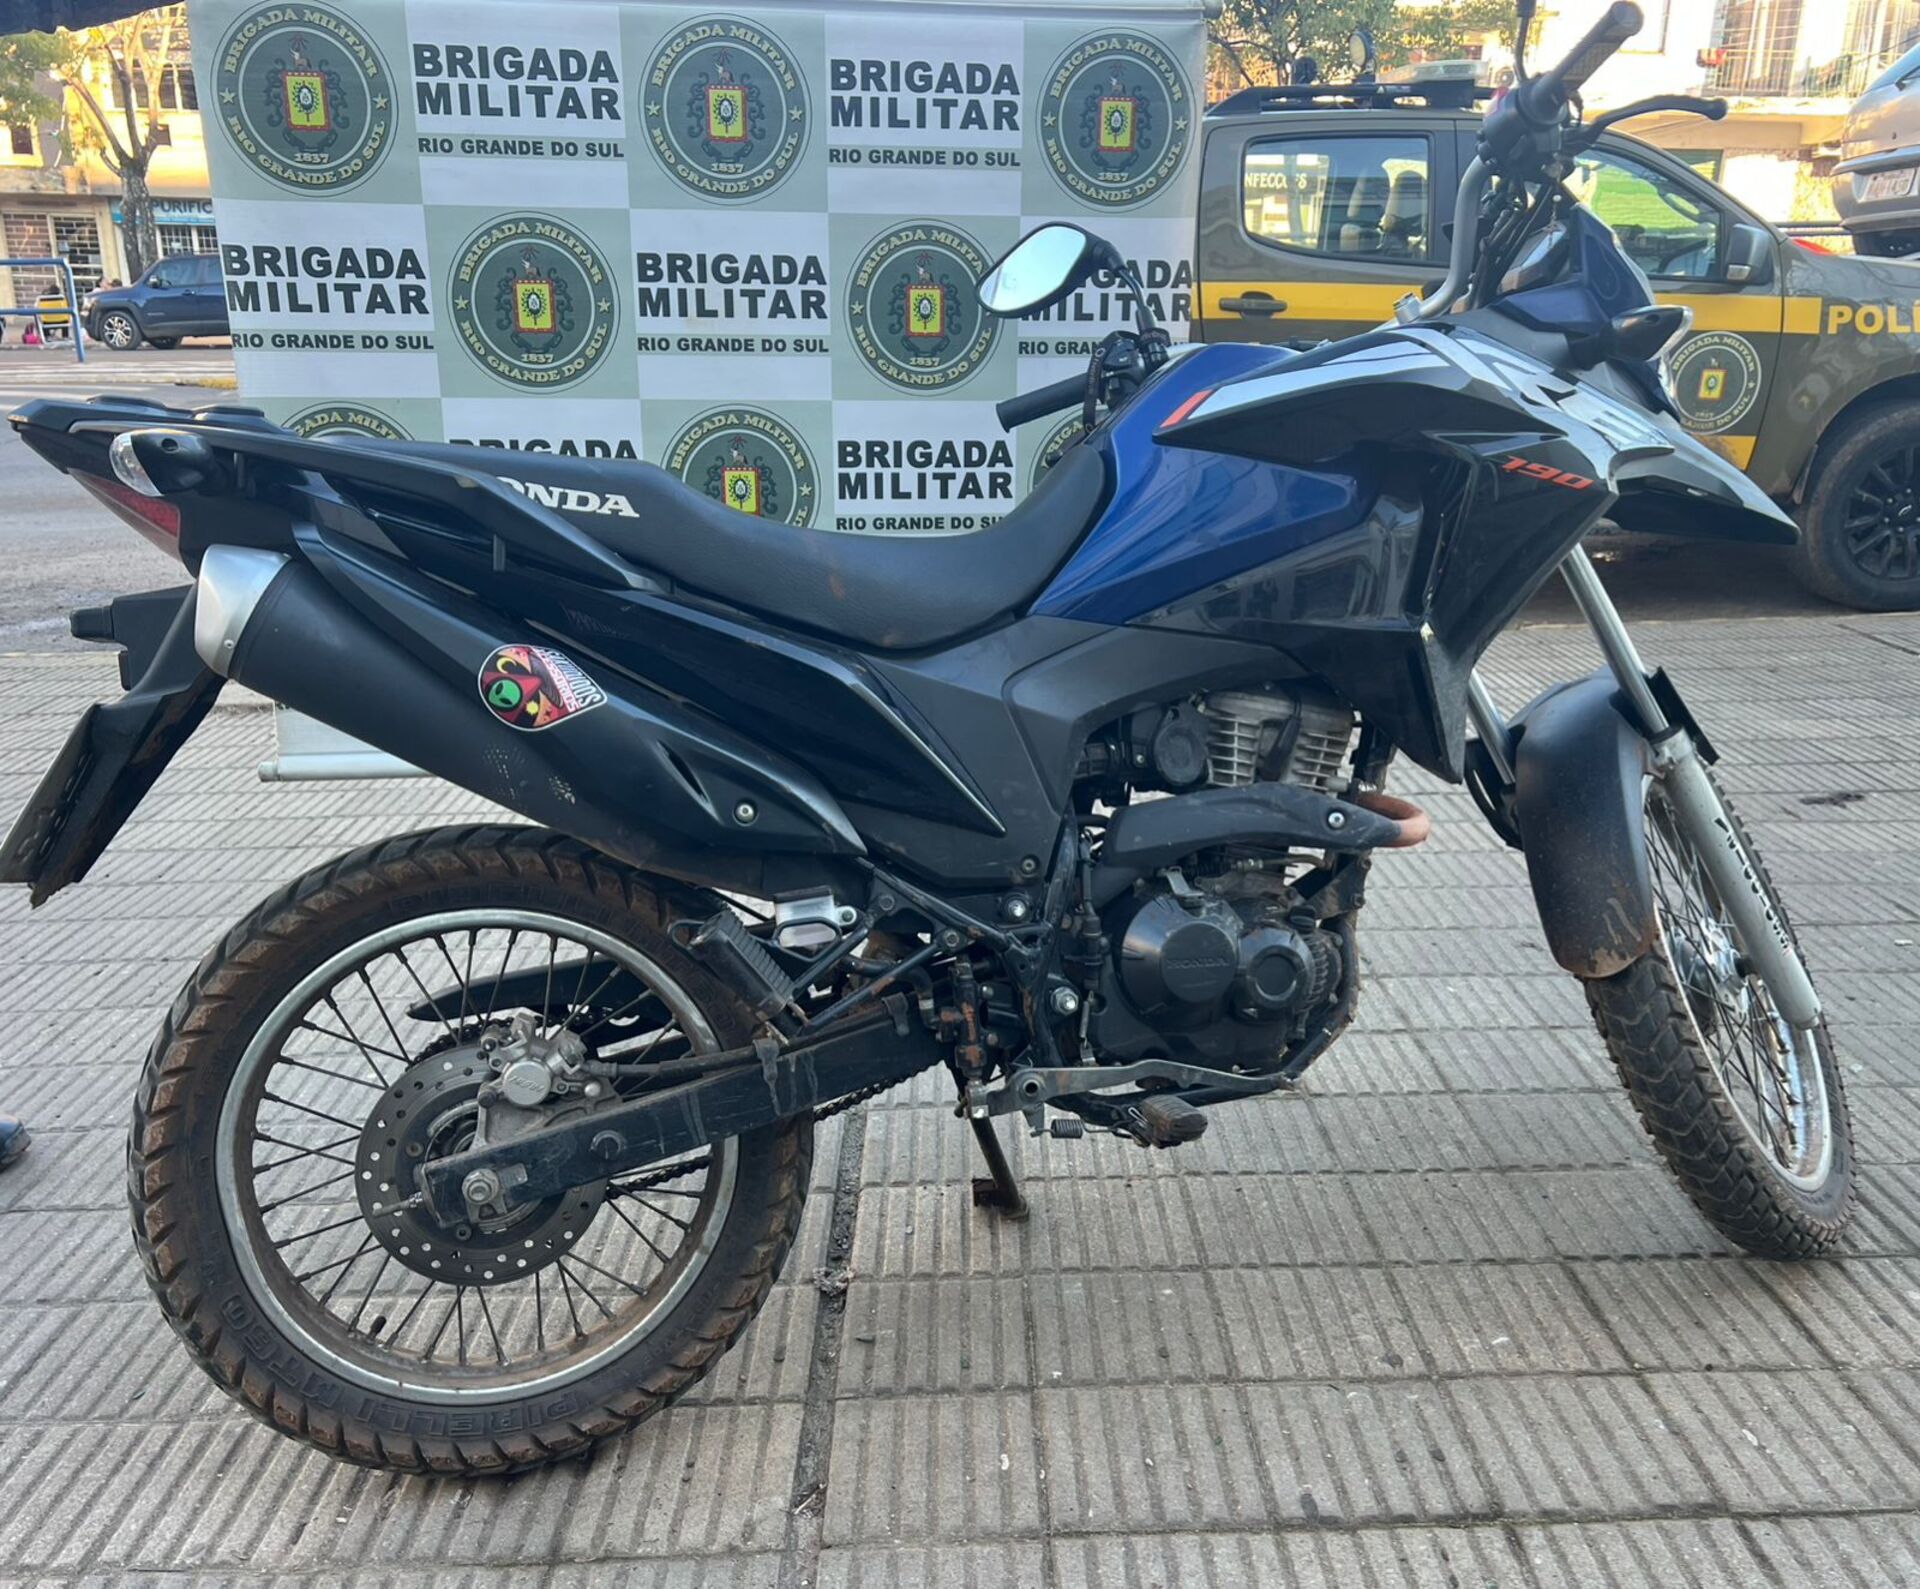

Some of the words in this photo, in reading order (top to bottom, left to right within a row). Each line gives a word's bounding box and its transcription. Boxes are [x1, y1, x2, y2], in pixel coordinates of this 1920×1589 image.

[224, 8, 299, 73] BRIGADA
[304, 9, 378, 77] MILITAR
[652, 24, 725, 88] BRIGADA
[729, 25, 797, 91] MILITAR
[412, 43, 619, 83] BRIGADA
[830, 59, 1020, 95] BRIGADA
[1050, 38, 1121, 98] BRIGADA
[1125, 39, 1183, 101] MILITAR
[416, 82, 621, 120] MILITAR
[831, 96, 1020, 131] MILITAR
[227, 116, 257, 154] RIO
[259, 154, 337, 185] GRANDE
[339, 158, 363, 179] DO
[363, 120, 385, 159] SUL
[294, 153, 329, 164] 1837
[418, 138, 454, 154] RIO
[461, 139, 545, 156] GRANDE
[551, 141, 578, 157] DO
[585, 143, 624, 158] SUL
[651, 127, 676, 165] RIO
[677, 164, 750, 193] GRANDE
[752, 169, 776, 188] DO
[775, 132, 800, 170] SUL
[829, 149, 862, 164] RIO
[868, 150, 946, 165] GRANDE
[953, 151, 979, 166] DO
[985, 152, 1020, 167] SUL
[1046, 138, 1067, 174] RIO
[1067, 173, 1133, 201] GRANDE
[1136, 176, 1157, 195] DO
[1157, 141, 1182, 178] SUL
[221, 244, 426, 280] BRIGADA
[459, 221, 530, 282] BRIGADA
[535, 222, 603, 284] MILITAR
[636, 252, 827, 285] BRIGADA
[856, 228, 927, 288] BRIGADA
[931, 229, 985, 275] MILITA
[1078, 260, 1192, 289] GADA
[226, 280, 430, 314] MILITAR
[638, 287, 828, 319] MILITAR
[232, 333, 264, 349] RIO
[271, 334, 355, 350] GRANDE
[361, 335, 389, 350] DO
[395, 335, 434, 350] SUL
[460, 320, 486, 356] RIO
[487, 354, 561, 382] GRANDE
[562, 358, 586, 377] DO
[585, 322, 609, 359] SUL
[520, 353, 554, 363] 1837
[637, 337, 670, 351] RIO
[677, 337, 755, 352] GRANDE
[761, 338, 787, 353] DO
[793, 339, 829, 353] SUL
[854, 325, 877, 359] RIO
[877, 357, 945, 385] GRANDE
[947, 361, 970, 379] DO
[969, 327, 992, 362] SUL
[1018, 341, 1049, 356] RIO
[1672, 336, 1720, 371] BRIGADA
[1722, 336, 1756, 372] MILITAR
[1716, 414, 1733, 426] DO
[670, 413, 740, 471] BRIGADA
[744, 414, 806, 471] MILITAR
[837, 440, 1014, 469] BRIGADA
[838, 472, 1013, 500] MILITAR
[1502, 455, 1595, 490] 190
[496, 475, 640, 518] NDA
[836, 517, 866, 532] RIO
[872, 517, 945, 531] GRANDE
[951, 516, 975, 530] DO
[353, 1390, 579, 1438] PIRELLI
